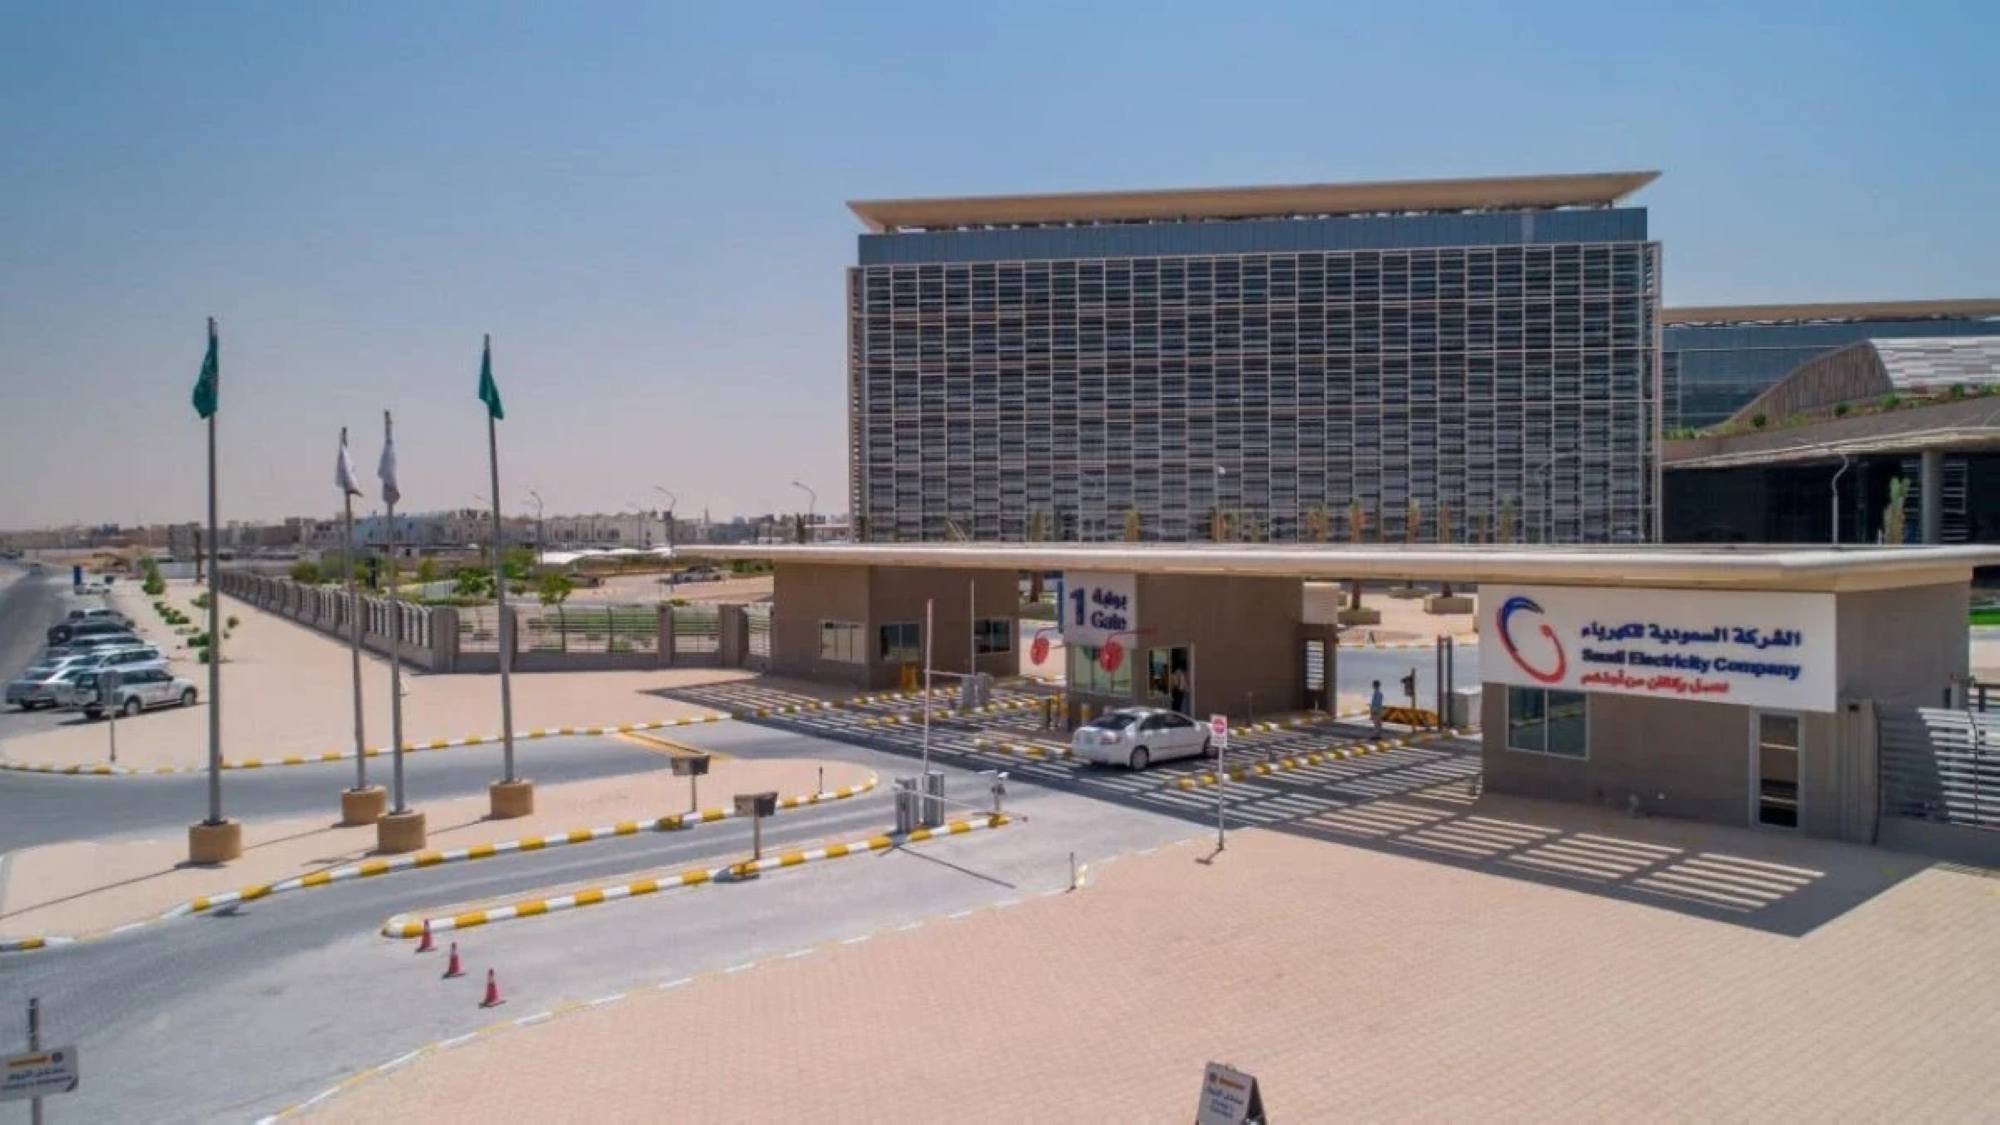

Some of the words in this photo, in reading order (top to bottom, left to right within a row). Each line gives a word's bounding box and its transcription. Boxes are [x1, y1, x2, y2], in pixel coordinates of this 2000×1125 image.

[1070, 588, 1084, 626] 1
[1091, 610, 1127, 630] Gate
[1581, 620, 1645, 642] للكهرباء
[1648, 622, 1728, 645] السعودية
[1732, 627, 1801, 650] الشركة
[1582, 648, 1626, 664] Saudi
[1628, 651, 1711, 675] Electricity
[1713, 657, 1801, 681] Company
